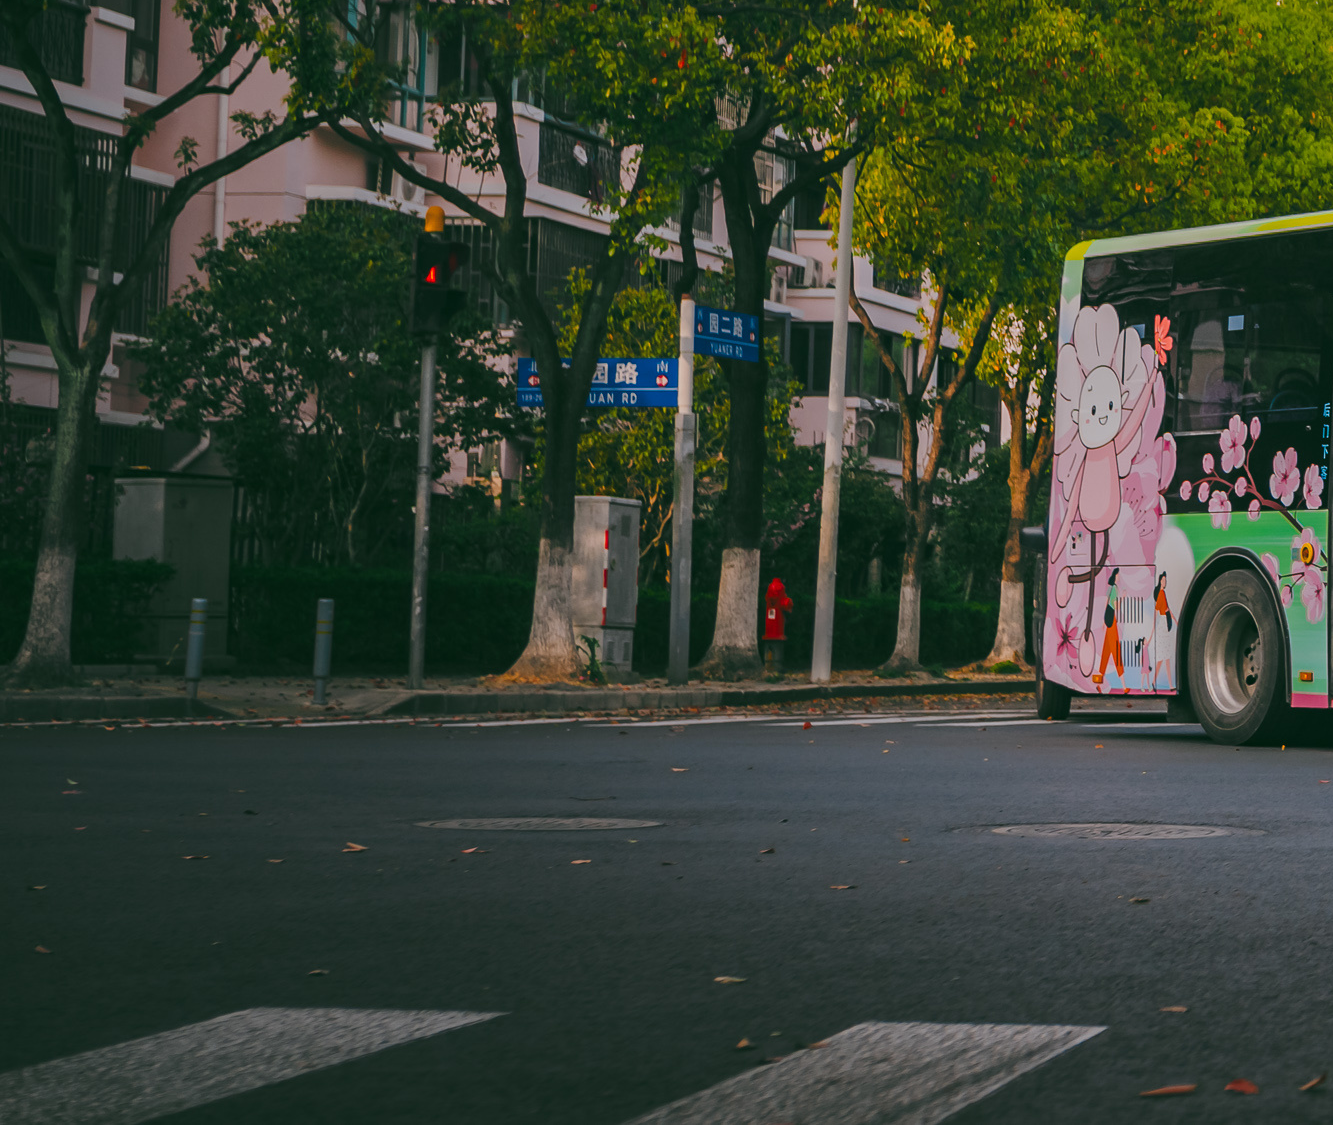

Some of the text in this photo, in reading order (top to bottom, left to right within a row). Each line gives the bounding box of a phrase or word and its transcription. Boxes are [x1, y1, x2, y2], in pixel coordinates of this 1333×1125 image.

[709, 312, 743, 338] 园二路
[621, 392, 638, 405] RD
